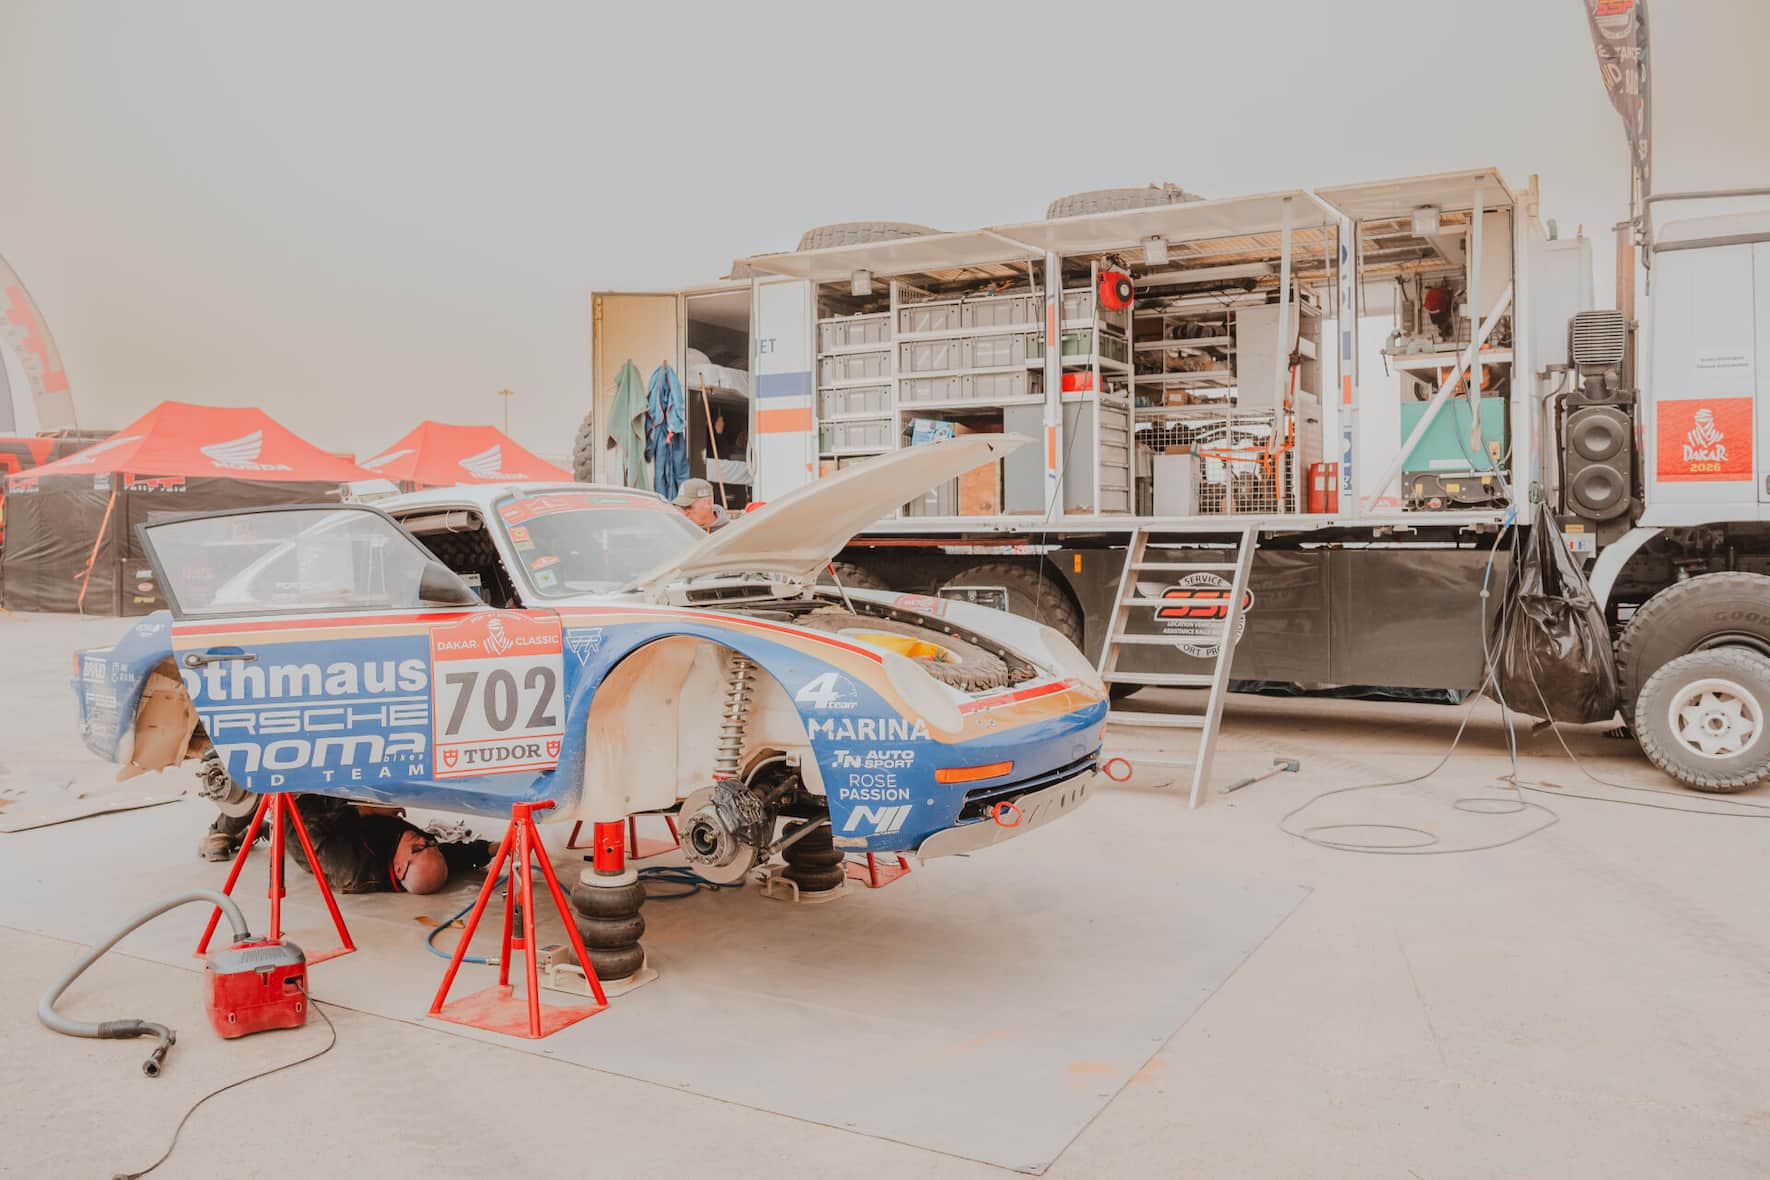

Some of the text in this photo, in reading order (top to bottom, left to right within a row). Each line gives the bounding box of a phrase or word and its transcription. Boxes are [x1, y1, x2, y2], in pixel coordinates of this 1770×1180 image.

[1682, 444, 1729, 462] DAKAR
[1690, 463, 1721, 473] 2026
[437, 634, 560, 650] DAKAR CLASSIC
[445, 666, 557, 736] 702
[808, 718, 932, 741] MARINA
[464, 743, 542, 764] TUDOR
[866, 750, 915, 760] AUTO
[864, 760, 914, 768] SPORT
[322, 763, 424, 783] TEAM
[849, 774, 897, 788] ROSE
[840, 788, 910, 801] PASSION
